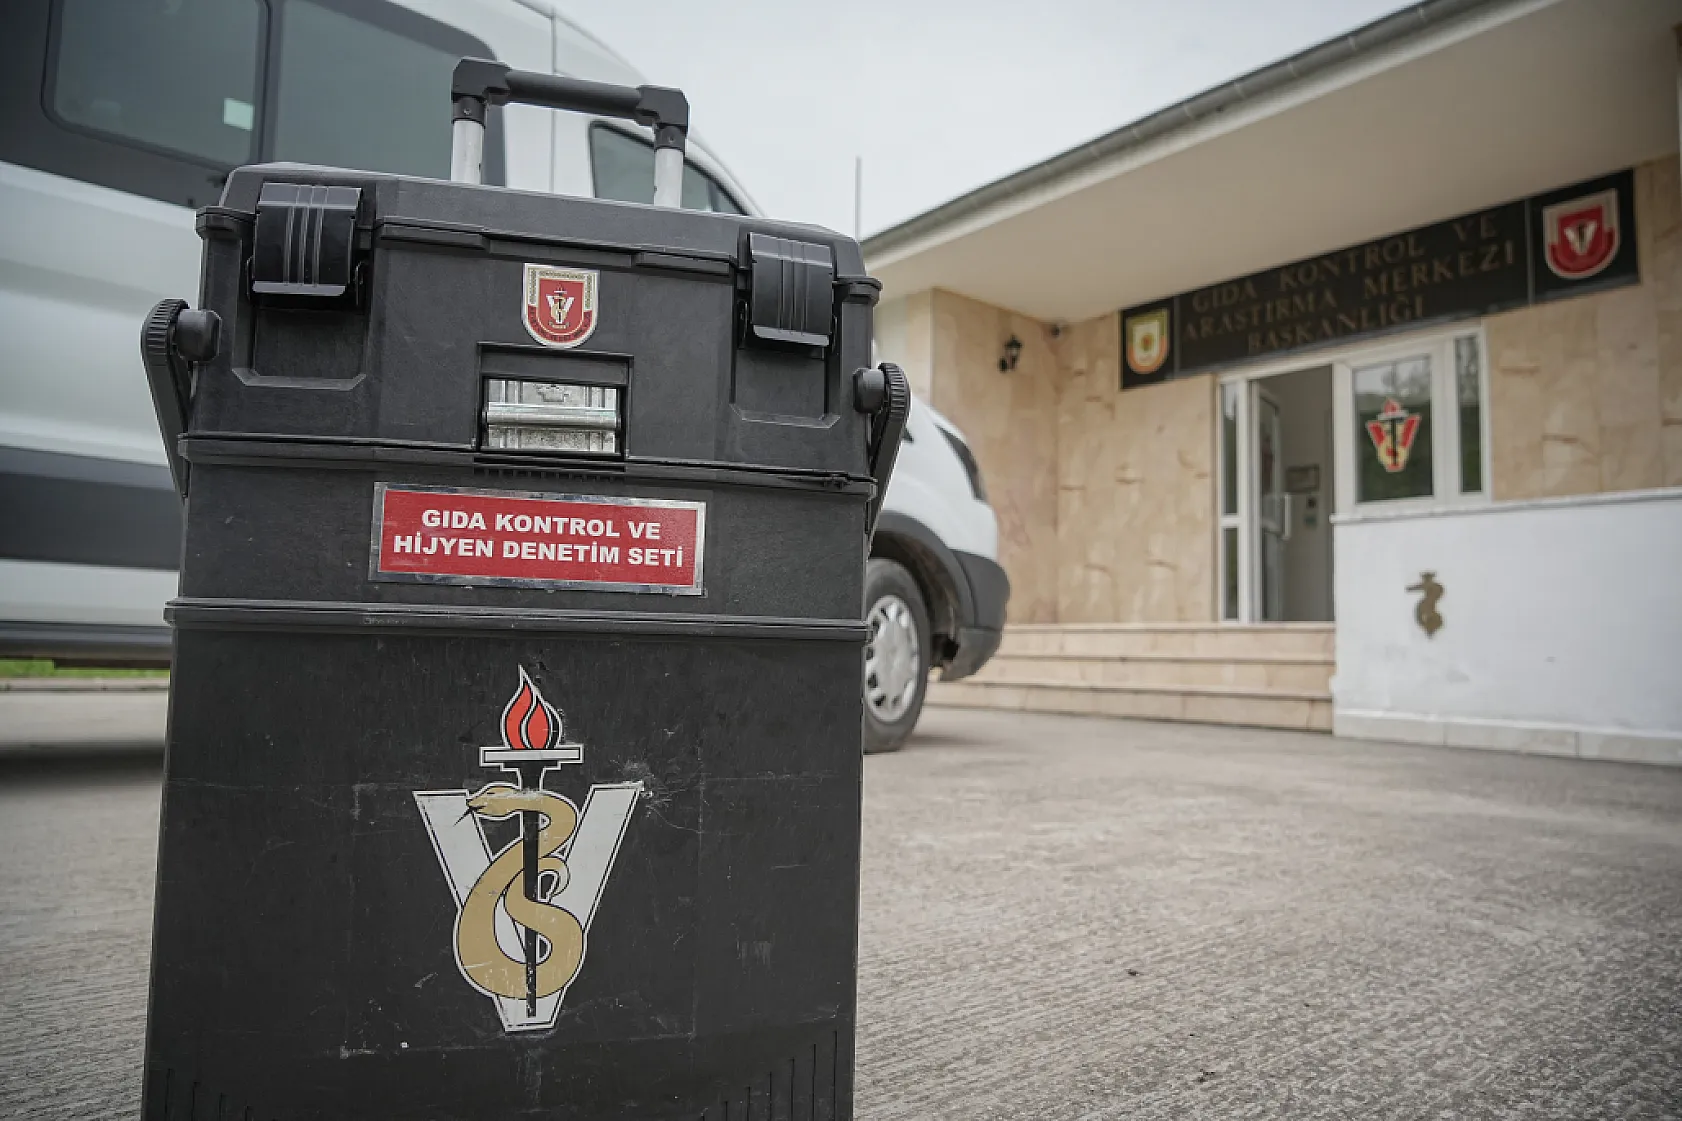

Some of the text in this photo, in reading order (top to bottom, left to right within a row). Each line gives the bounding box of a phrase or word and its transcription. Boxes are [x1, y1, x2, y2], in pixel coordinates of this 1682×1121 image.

[1192, 213, 1496, 312] GIDA KONTROL VE
[421, 509, 662, 541] GIDA KONTROL VE
[393, 531, 684, 568] HİJYEN DENETİM SETİ
